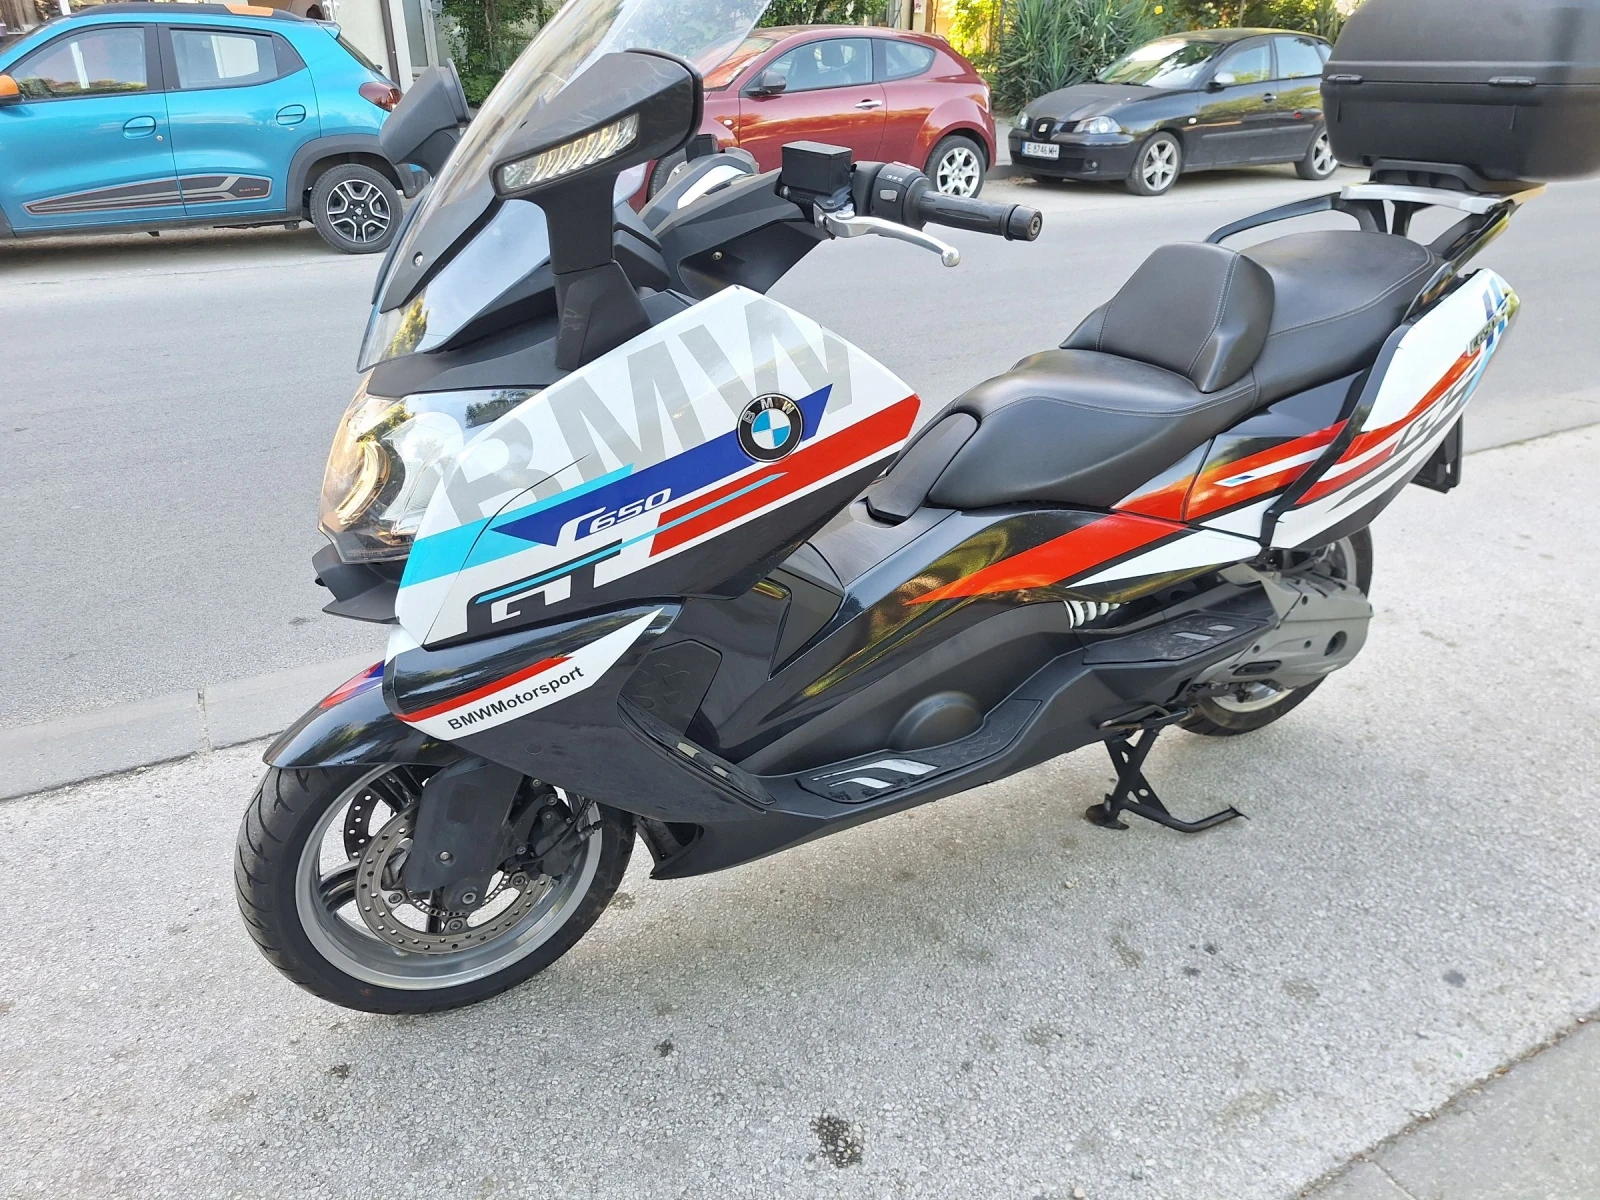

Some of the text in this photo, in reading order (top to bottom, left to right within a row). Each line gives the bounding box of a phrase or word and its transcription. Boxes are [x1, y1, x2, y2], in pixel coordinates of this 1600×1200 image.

[442, 299, 852, 525] BMW
[742, 397, 795, 424] BMW
[448, 666, 584, 730] BMWMotorsport
